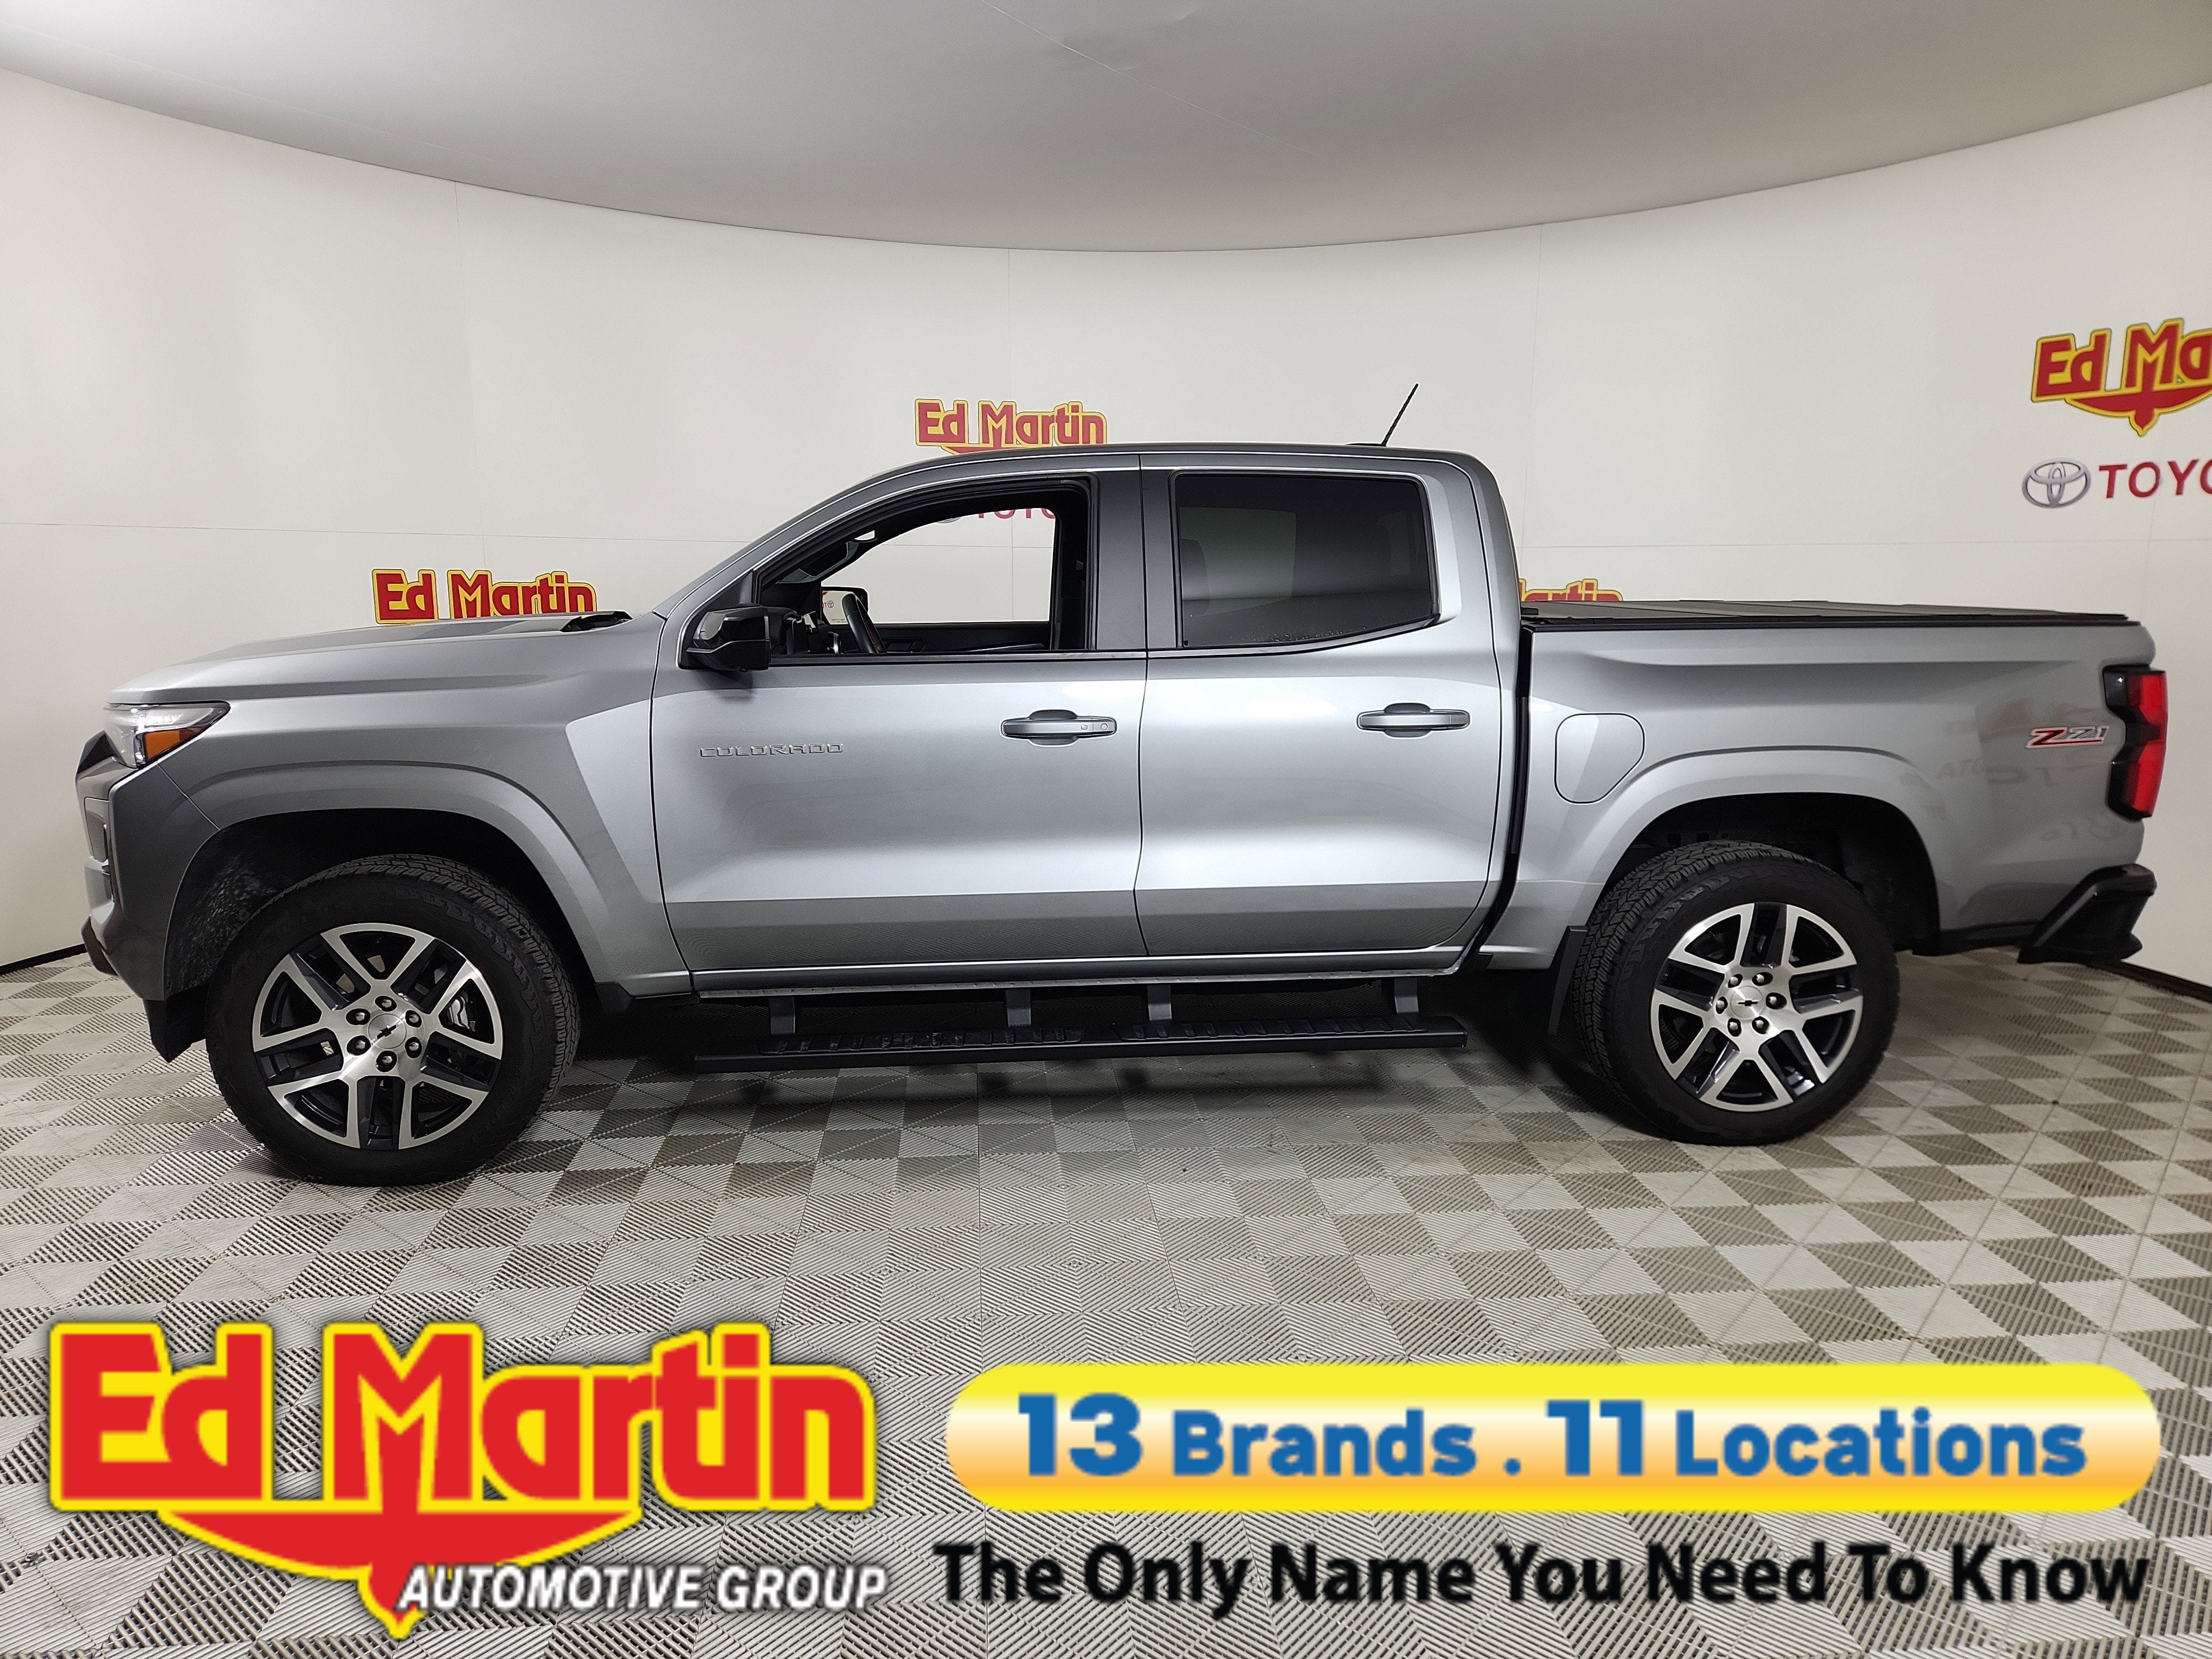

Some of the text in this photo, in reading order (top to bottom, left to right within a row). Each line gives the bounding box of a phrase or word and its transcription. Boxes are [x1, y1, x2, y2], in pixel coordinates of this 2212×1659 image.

[2032, 330, 2111, 401] Ed
[916, 400, 1106, 447] Ed Martin
[373, 570, 596, 623] Ed Martin
[700, 743, 843, 757] COLORADO
[2027, 725, 2110, 748] Z71
